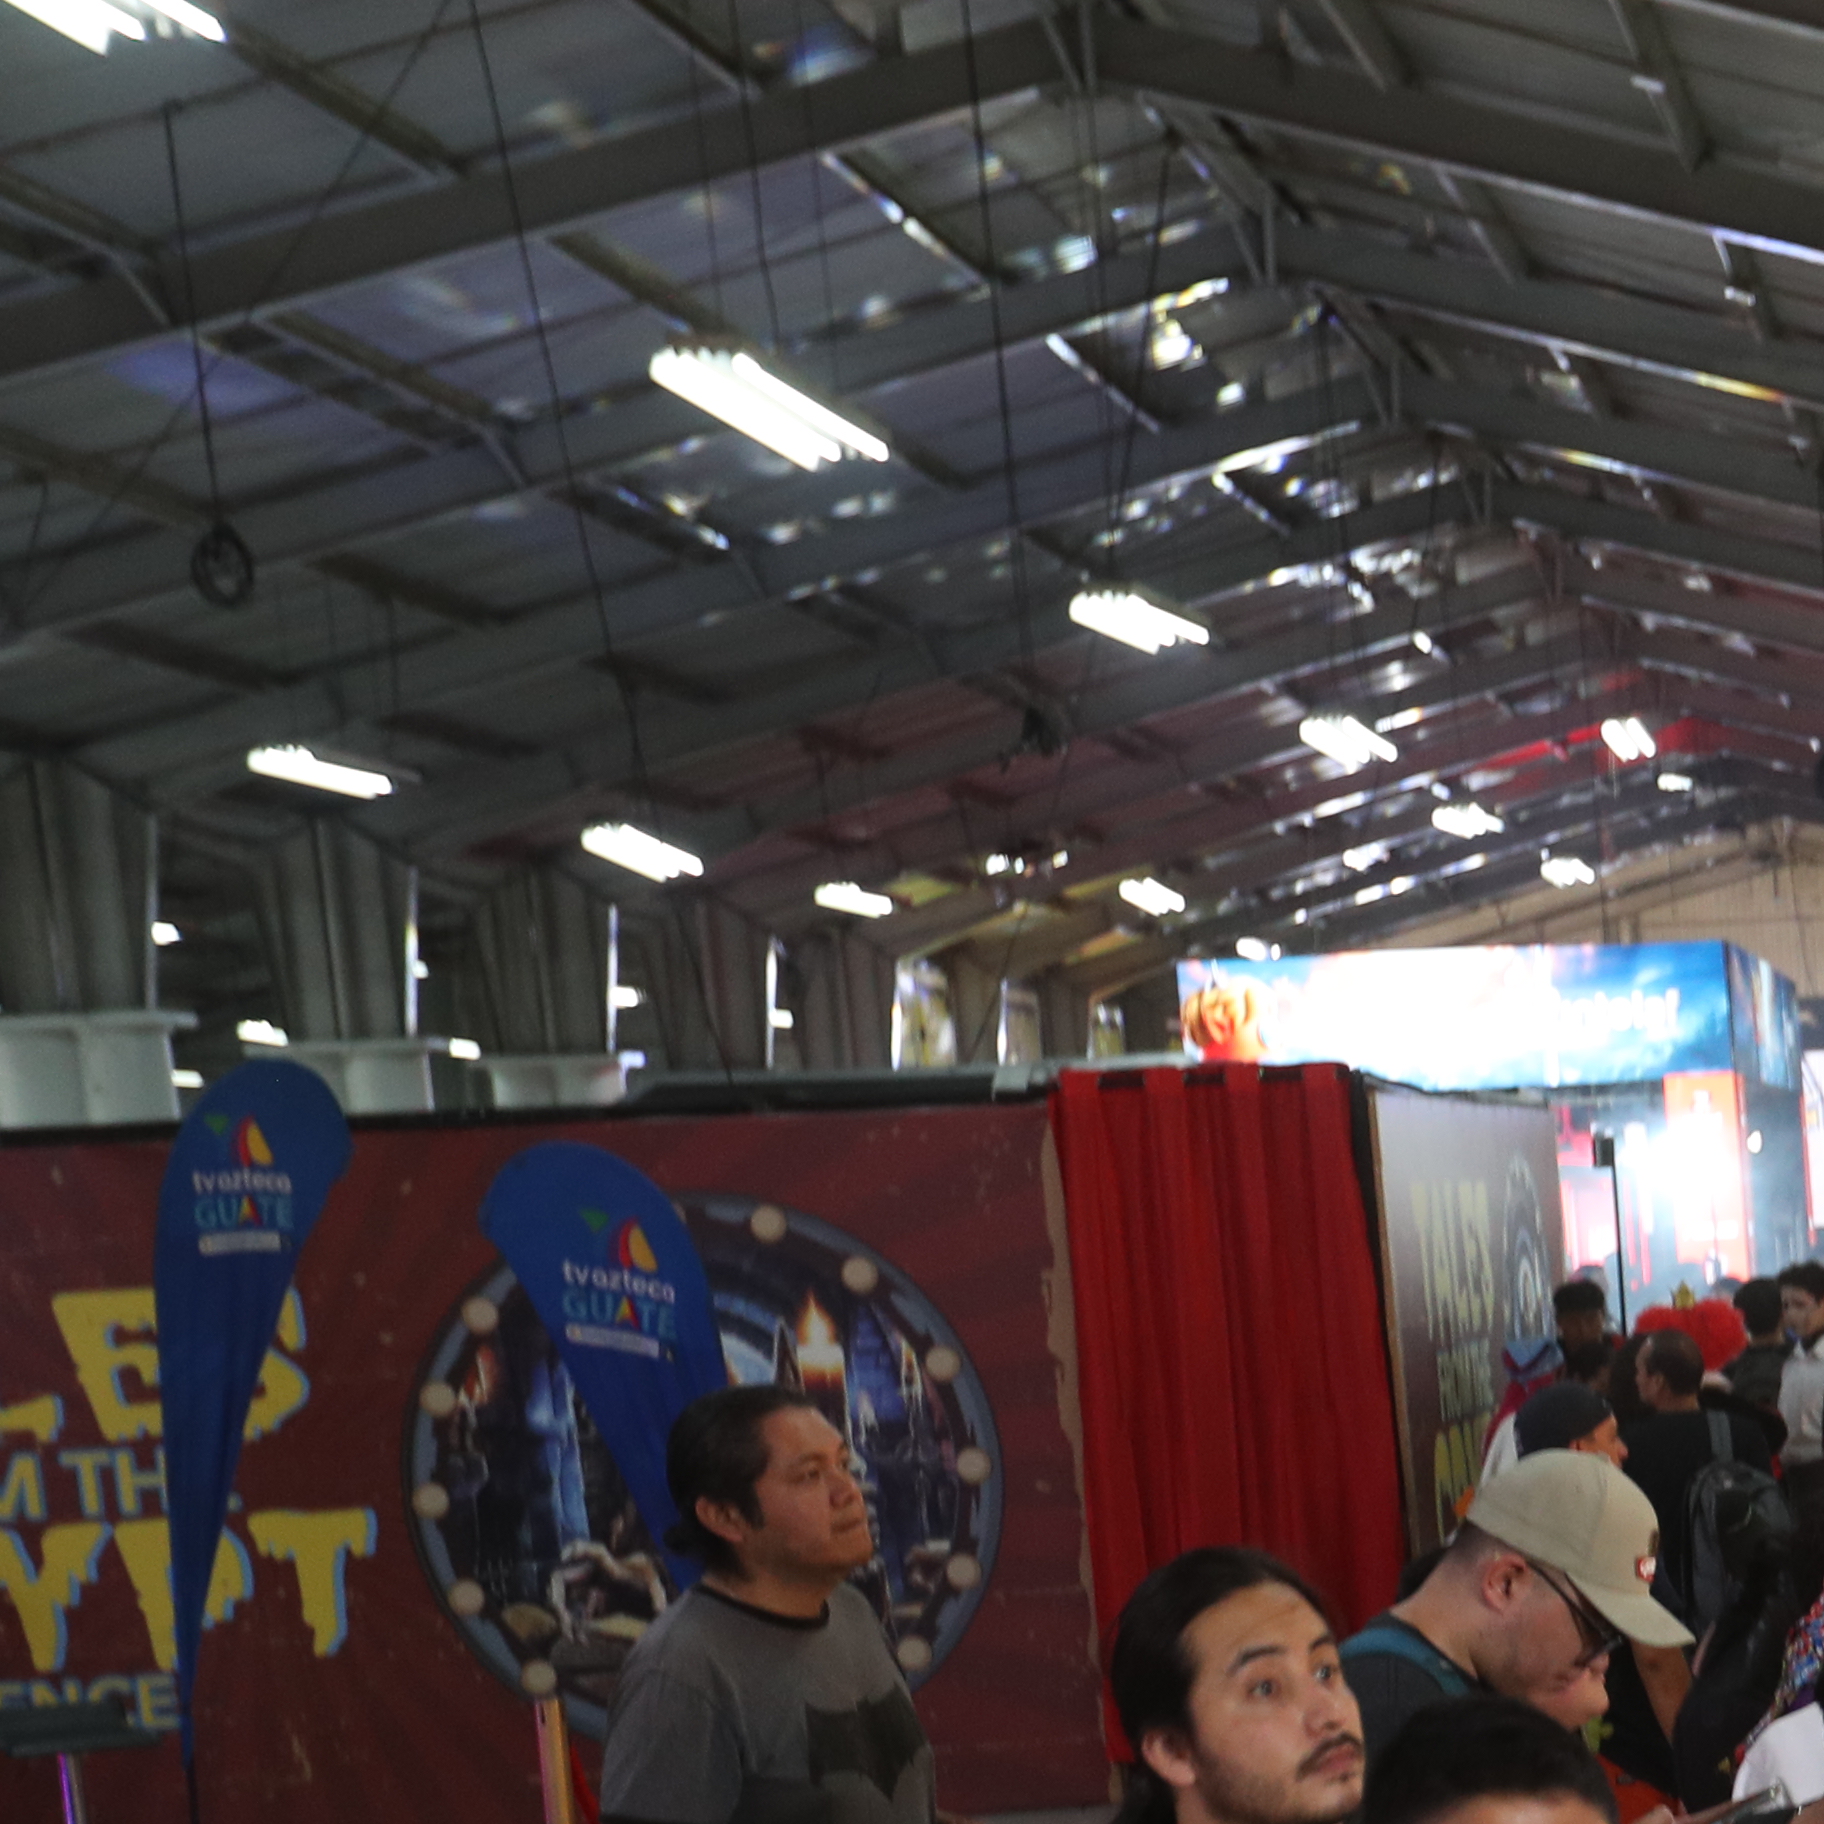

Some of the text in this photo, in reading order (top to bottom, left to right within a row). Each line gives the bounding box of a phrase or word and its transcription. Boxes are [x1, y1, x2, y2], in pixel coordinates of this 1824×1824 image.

[193, 1193, 295, 1231] GUATE
[1408, 1178, 1495, 1347] TALES
[561, 1287, 678, 1341] GUATE
[58, 1446, 243, 1522] TH
